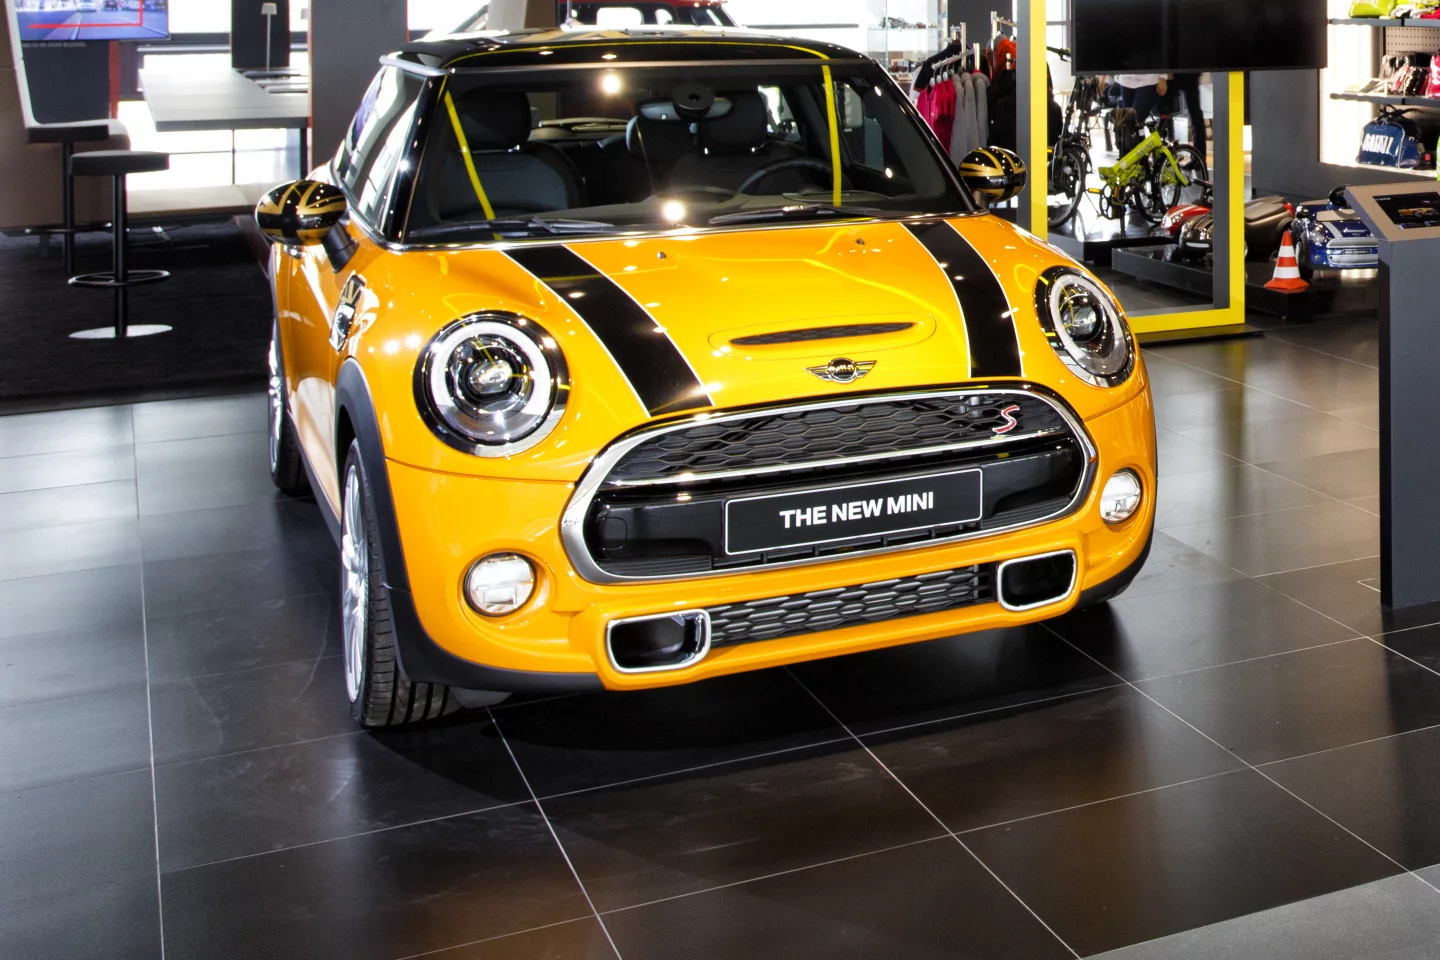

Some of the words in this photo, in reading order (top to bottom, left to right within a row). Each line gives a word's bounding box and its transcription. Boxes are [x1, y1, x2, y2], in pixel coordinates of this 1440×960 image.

[993, 404, 1020, 435] S
[779, 505, 827, 529] THE
[831, 498, 883, 522] NEW
[887, 491, 934, 515] MINI
